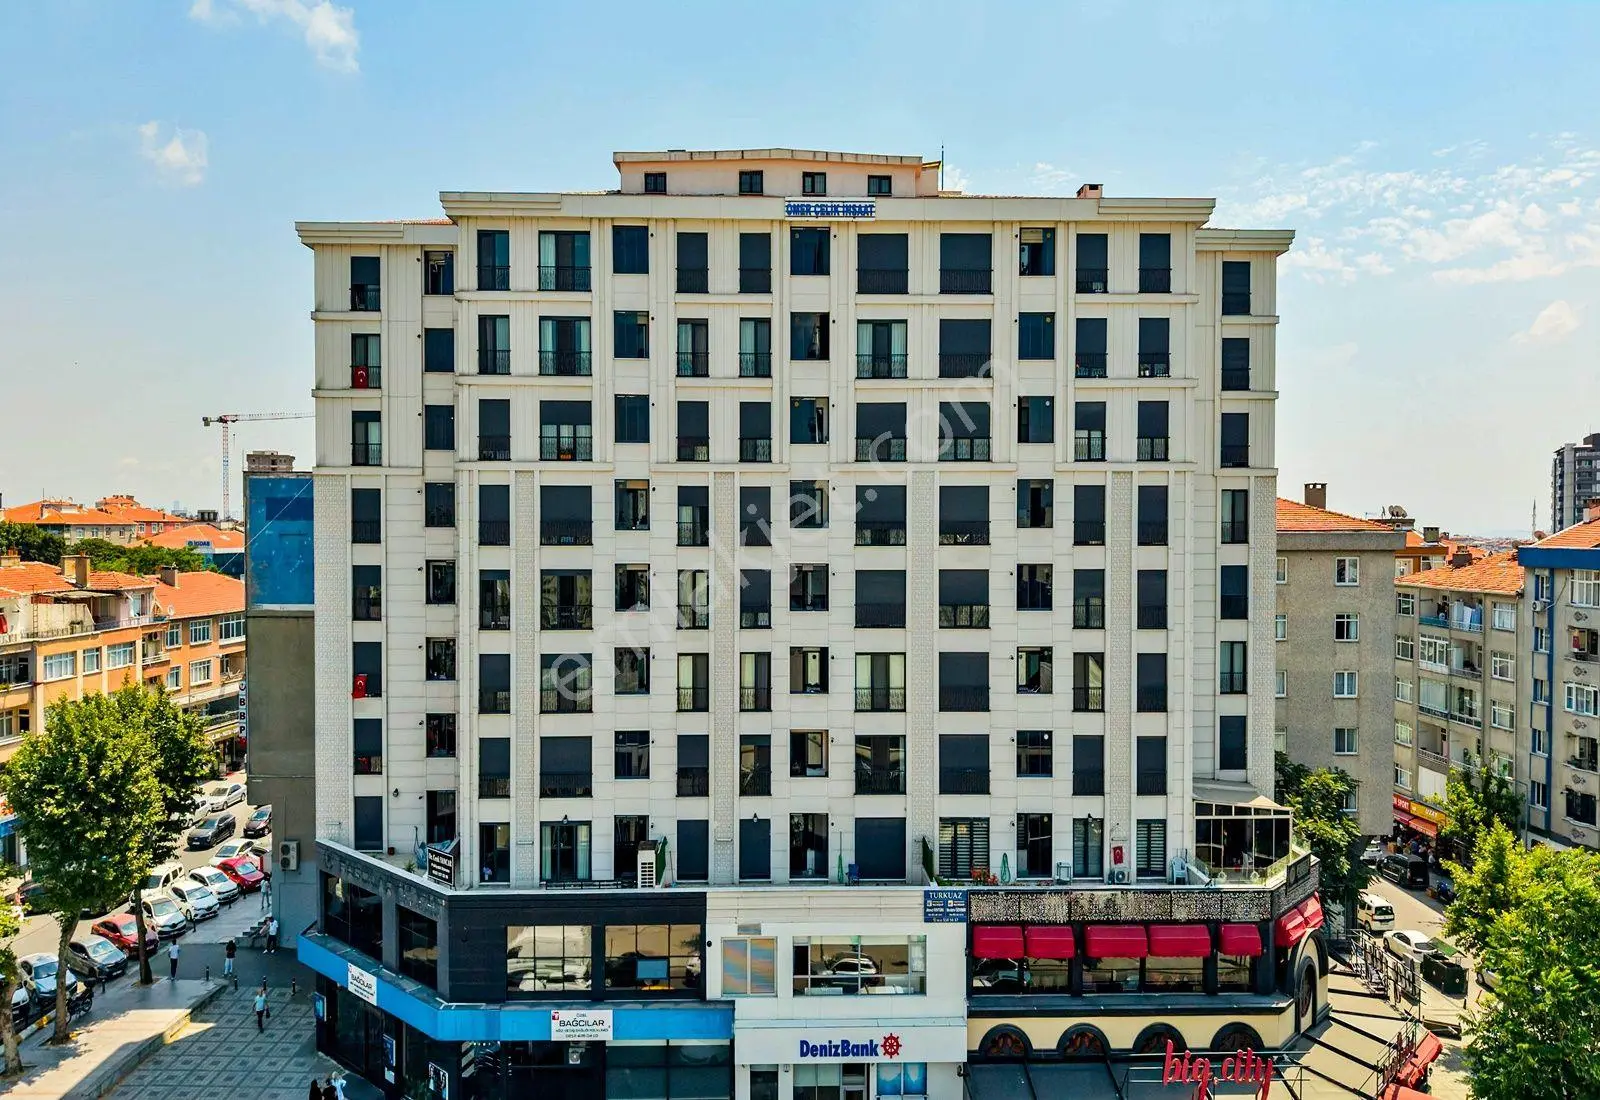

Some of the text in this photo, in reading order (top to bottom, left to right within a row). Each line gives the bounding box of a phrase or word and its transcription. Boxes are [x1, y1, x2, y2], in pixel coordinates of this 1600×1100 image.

[799, 1039, 879, 1058] DenizBank
[1162, 1039, 1276, 1100] big city
